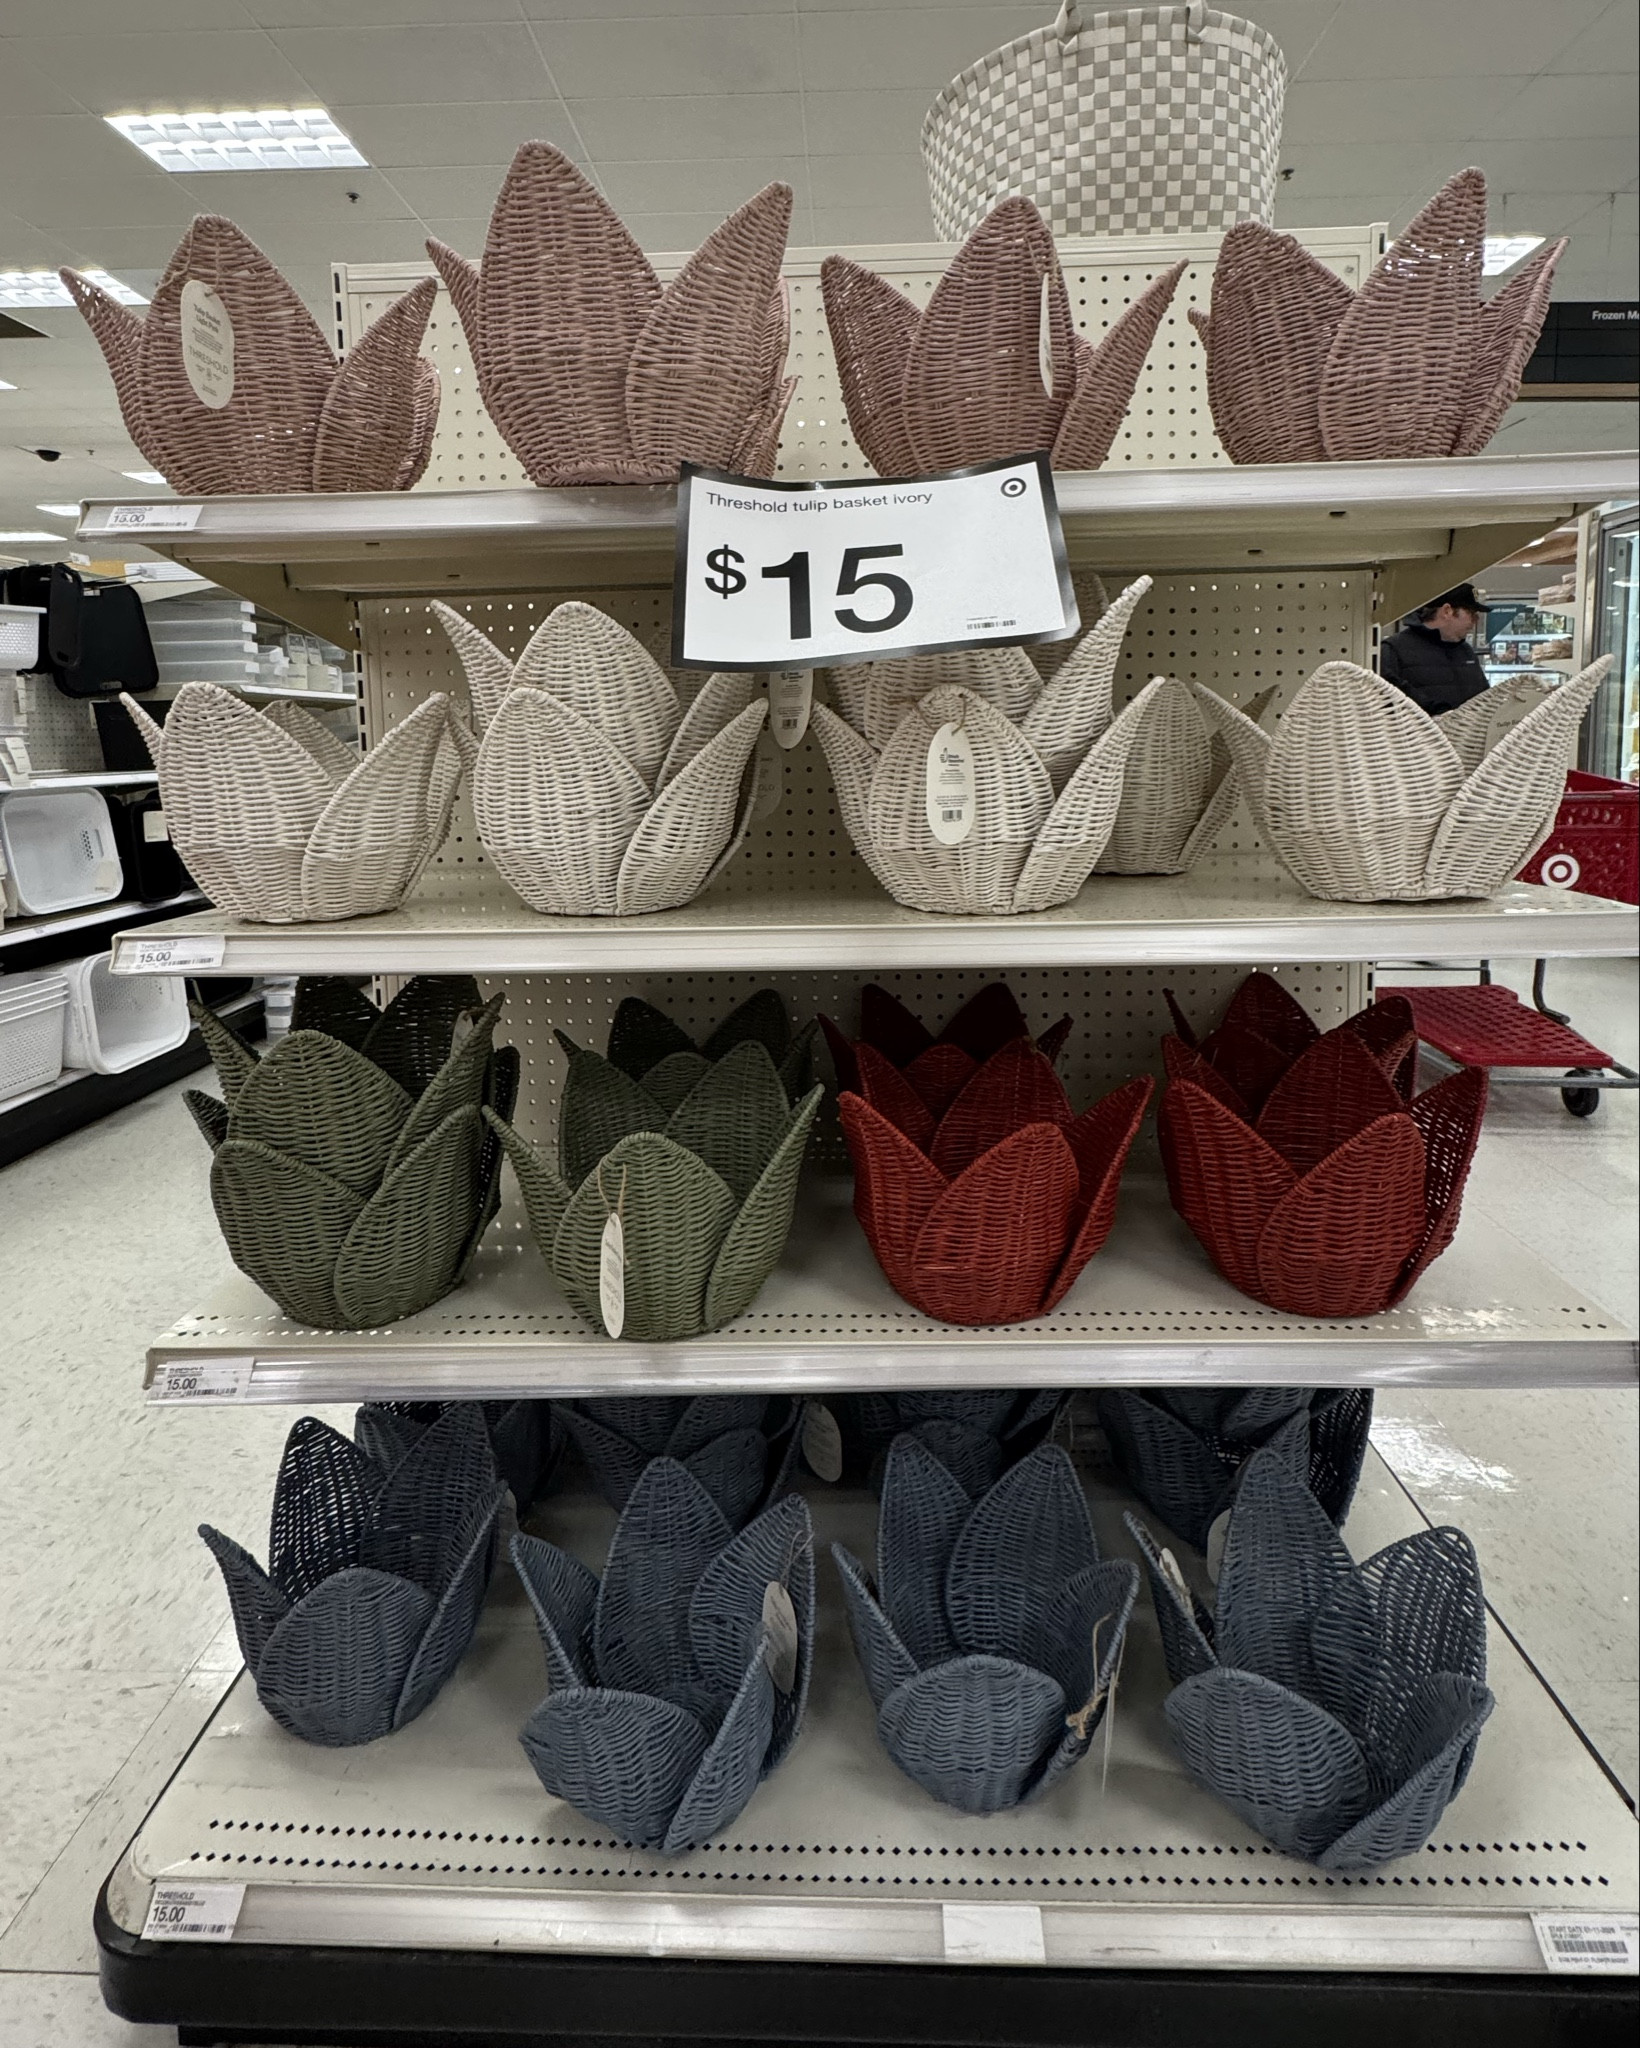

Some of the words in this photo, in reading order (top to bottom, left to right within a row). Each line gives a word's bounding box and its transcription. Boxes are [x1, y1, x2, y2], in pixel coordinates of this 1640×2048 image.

[1592, 310, 1626, 320] Frozen
[189, 344, 229, 375] THRESHOLD
[706, 492, 787, 513] Threshold
[793, 501, 828, 513] tulip
[833, 496, 888, 509] basket
[893, 492, 933, 505] ivory
[113, 514, 145, 523] 15.00
[140, 952, 171, 963] 15.00
[167, 1378, 197, 1391] 15.00
[157, 1891, 195, 1900] THRESHOLD
[153, 1906, 186, 1922] 15.00
